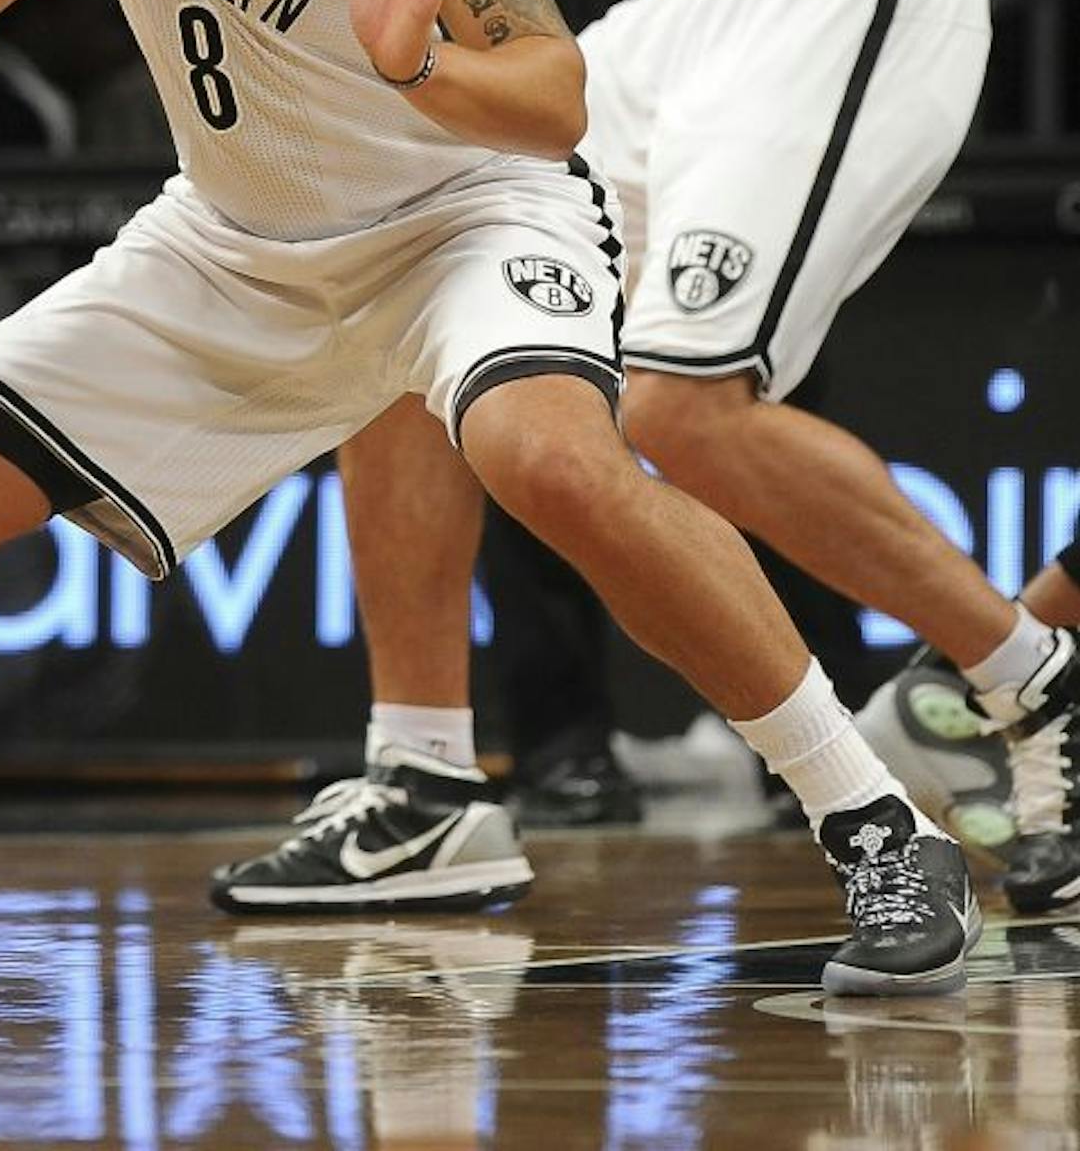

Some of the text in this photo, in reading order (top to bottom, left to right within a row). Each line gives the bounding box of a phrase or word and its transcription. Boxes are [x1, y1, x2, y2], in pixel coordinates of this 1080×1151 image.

[177, 3, 239, 132] 8
[509, 256, 594, 304] NETS
[670, 232, 752, 281] NETS
